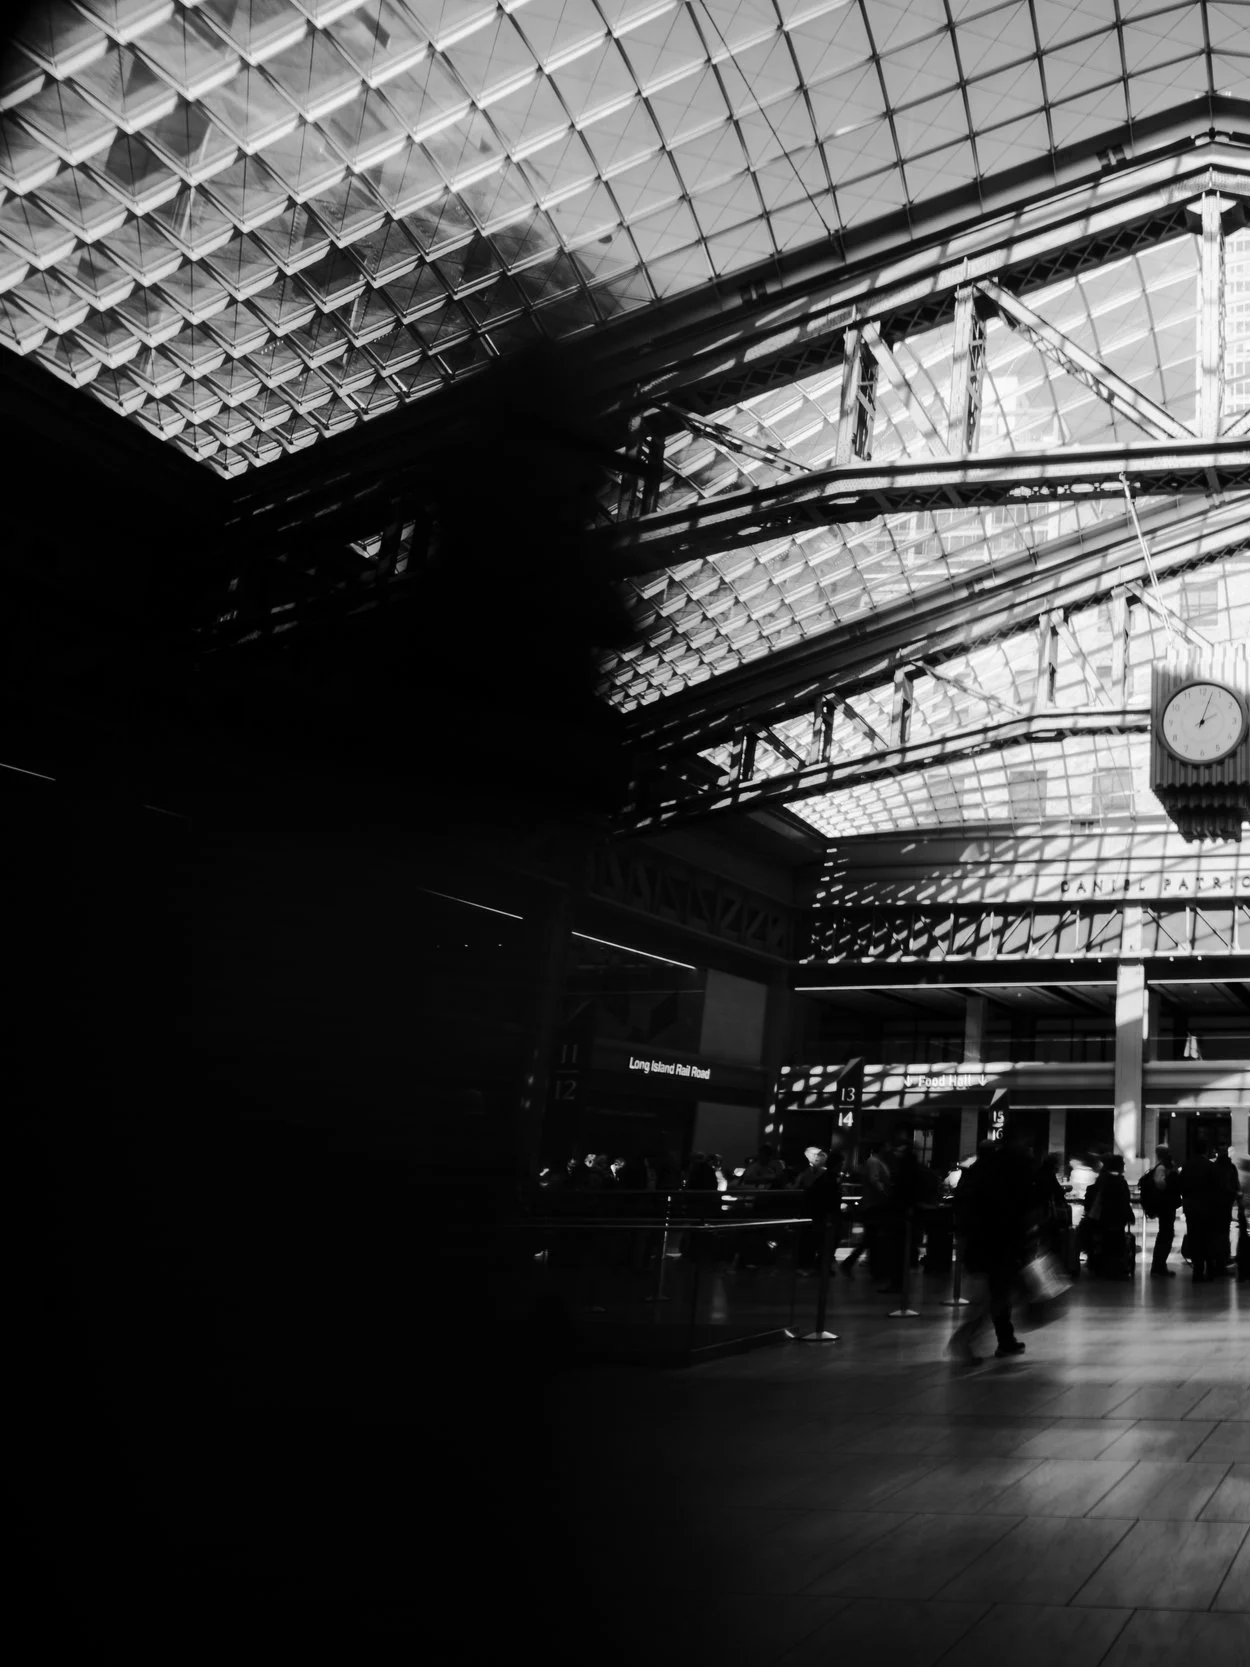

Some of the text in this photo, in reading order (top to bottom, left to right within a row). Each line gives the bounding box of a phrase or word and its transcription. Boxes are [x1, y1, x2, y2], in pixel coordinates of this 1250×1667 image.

[1060, 878, 1145, 893] DANIEL
[560, 1044, 579, 1064] 11
[629, 1056, 711, 1080] Long Island Rail Road
[918, 1074, 972, 1088] Food Hall
[555, 1080, 577, 1100] 12
[841, 1087, 856, 1102] 13
[838, 1111, 854, 1127] 14
[992, 1110, 1005, 1123] 15
